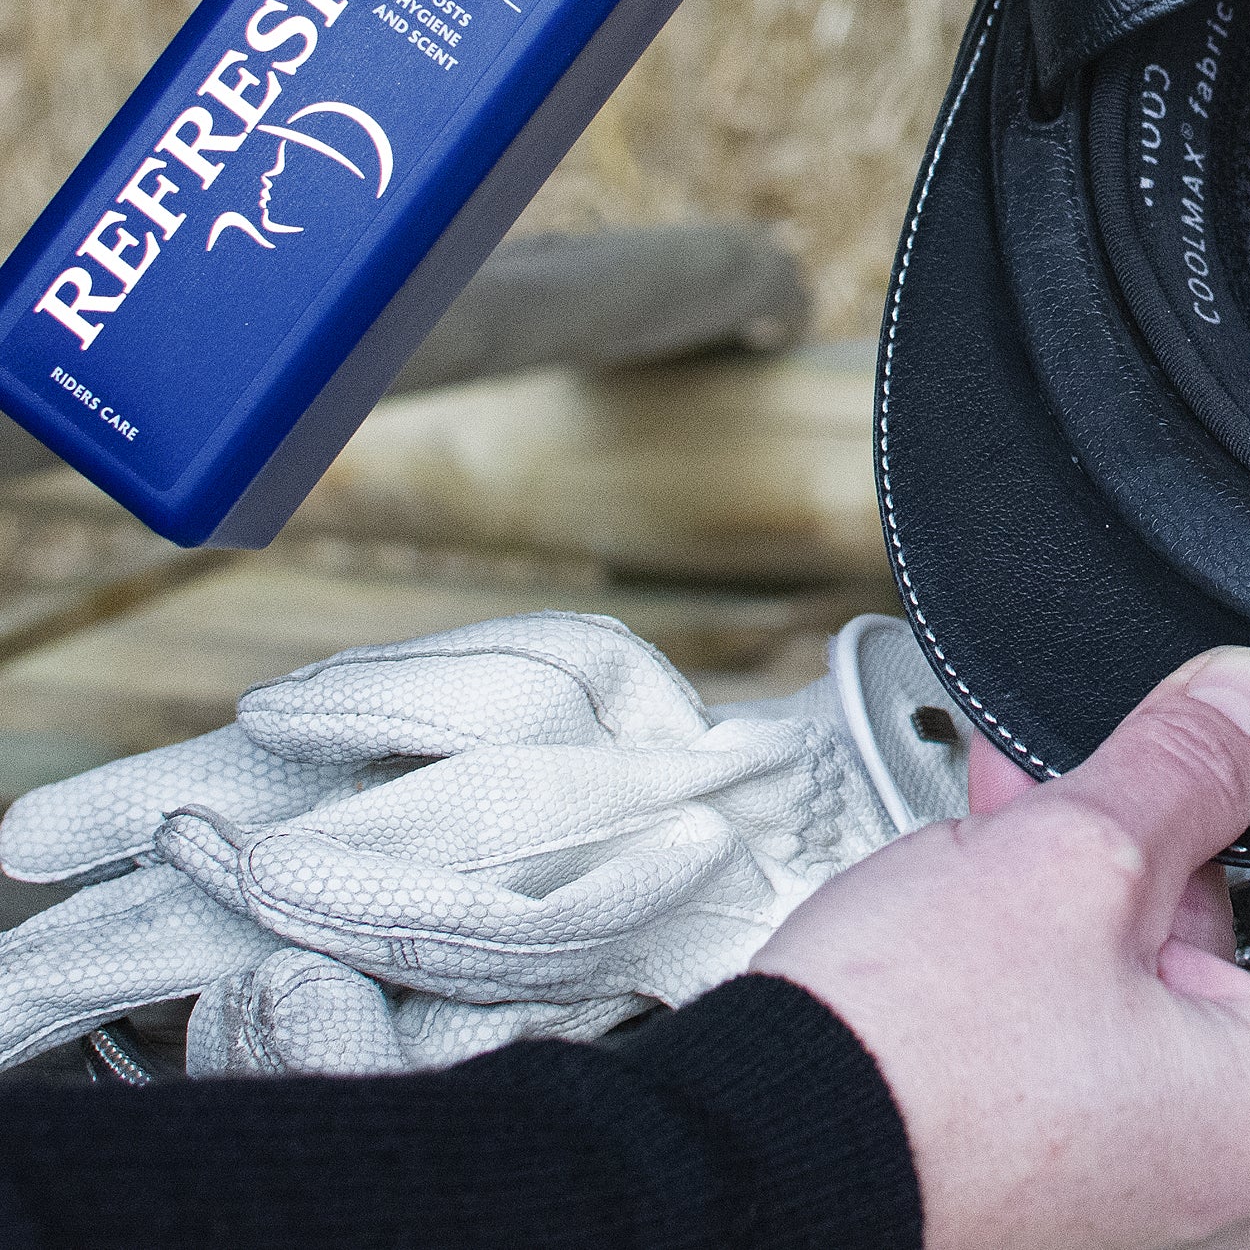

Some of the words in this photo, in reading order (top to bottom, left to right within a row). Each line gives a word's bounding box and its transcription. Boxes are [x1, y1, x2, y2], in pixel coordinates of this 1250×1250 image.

[372, 3, 409, 34] AND
[407, 29, 459, 71] SCENT
[1188, 0, 1236, 119] fabric
[50, 366, 101, 410] RIDERS
[100, 407, 139, 441] CARE
